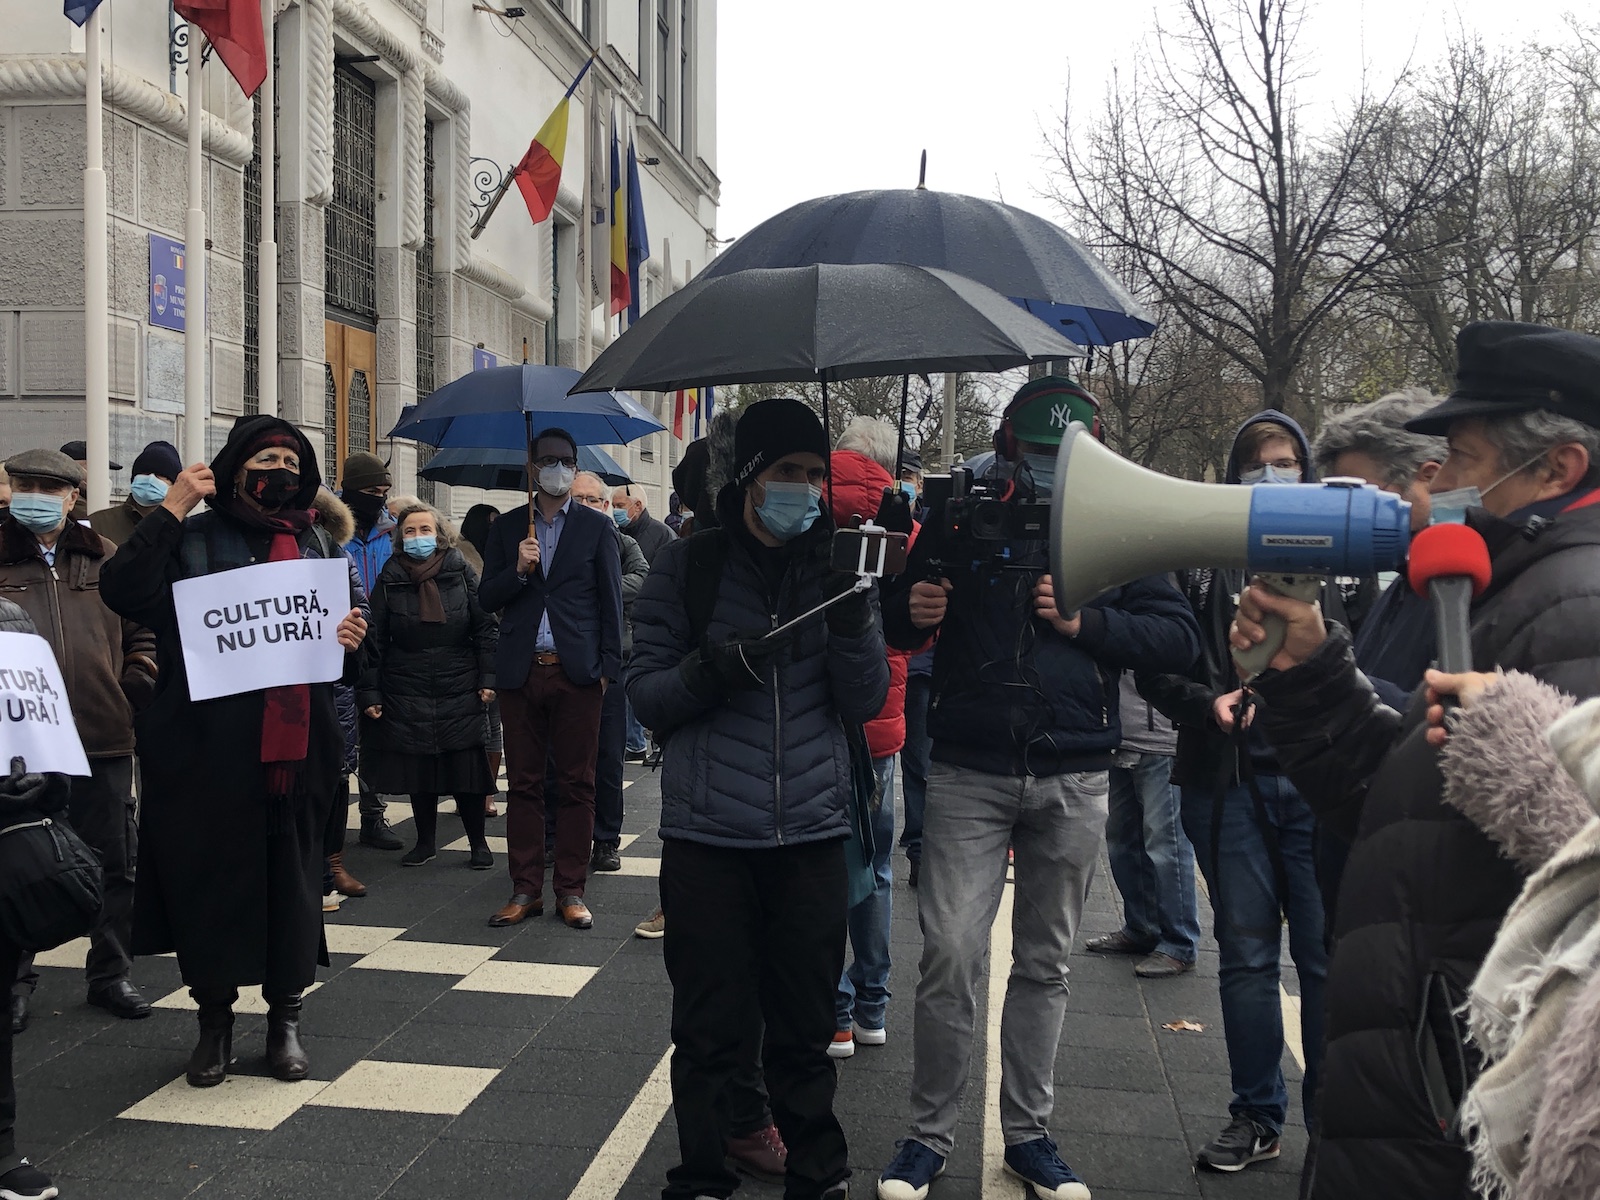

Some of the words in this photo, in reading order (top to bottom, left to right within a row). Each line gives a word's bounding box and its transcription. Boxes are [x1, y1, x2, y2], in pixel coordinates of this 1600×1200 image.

[1050, 403, 1072, 428] NY
[203, 589, 329, 629] CULTURĂ,
[216, 628, 256, 654] NU
[0, 666, 59, 700] TURĂ,
